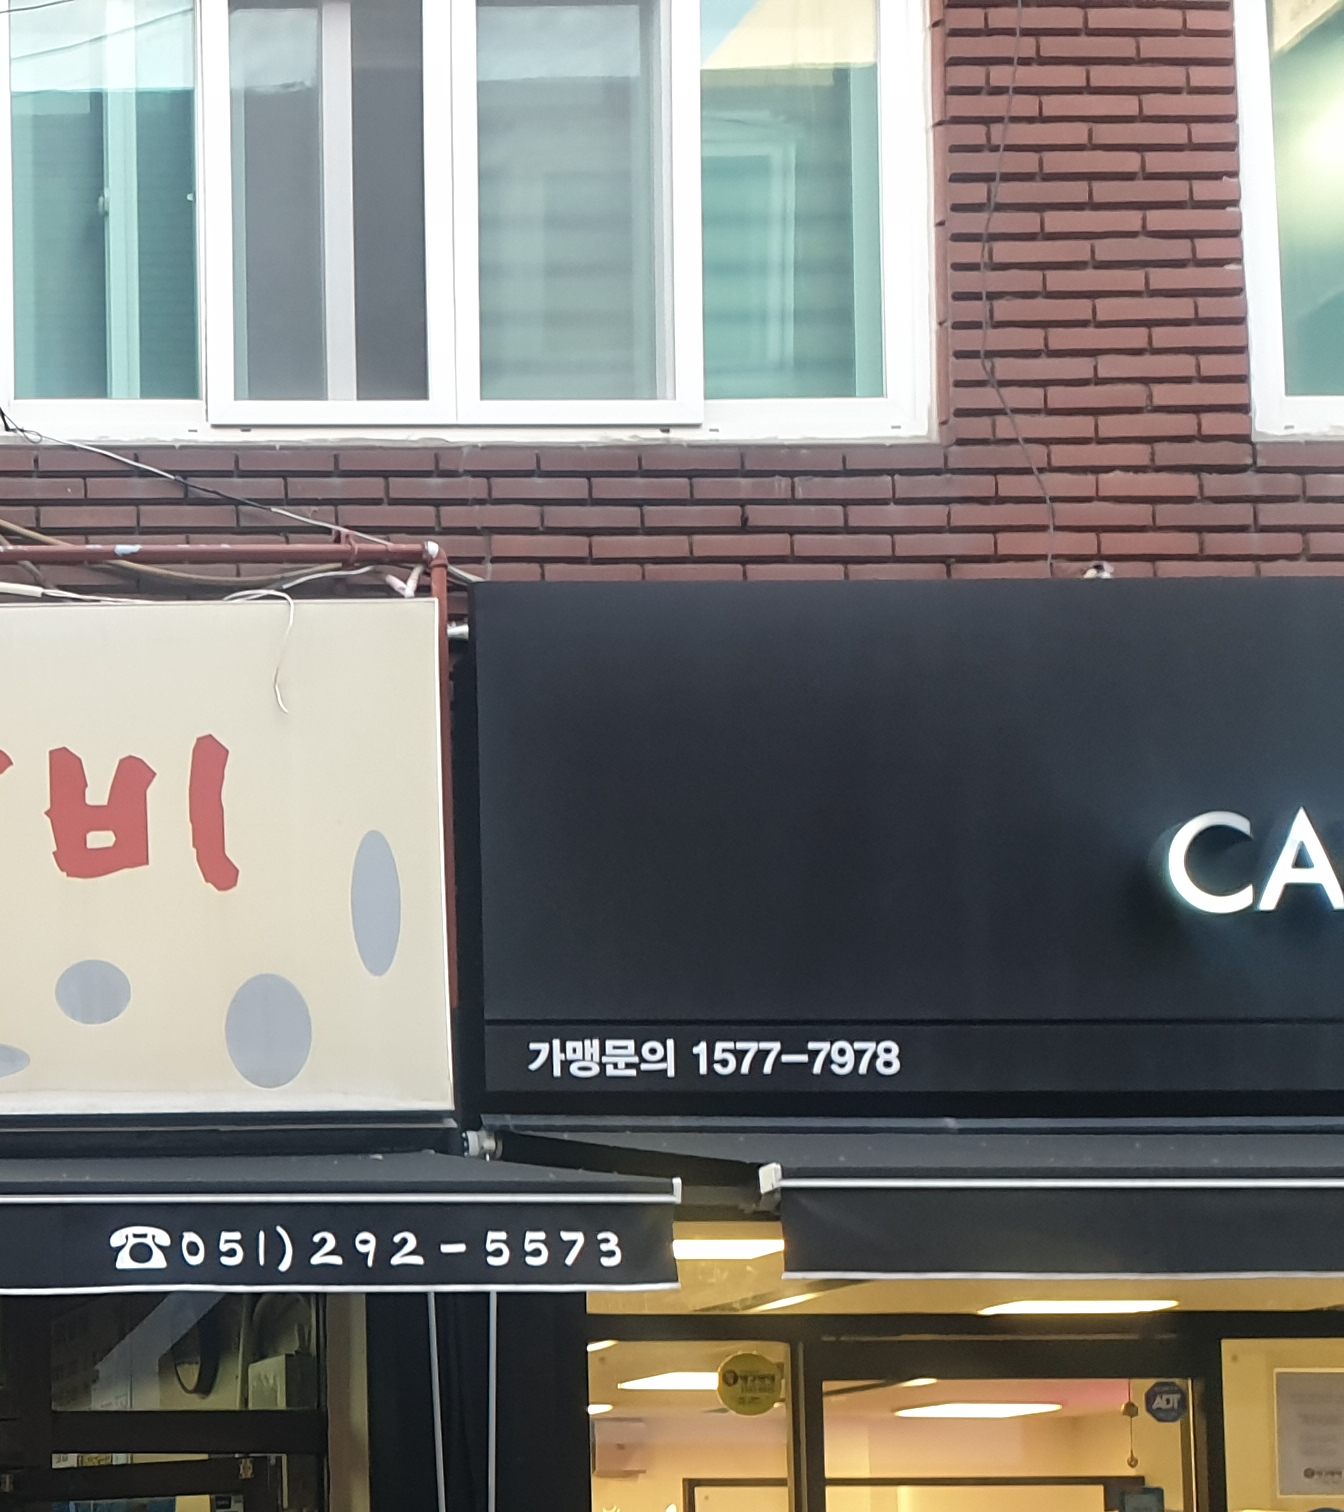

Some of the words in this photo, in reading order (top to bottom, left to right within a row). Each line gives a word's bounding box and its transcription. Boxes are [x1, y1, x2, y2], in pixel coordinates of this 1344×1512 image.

[526, 1037, 677, 1078] 가맹문의
[691, 1041, 901, 1076] 1577-7978
[181, 1225, 622, 1272] 051)292-5573
[1152, 1393, 1181, 1409] ADT
